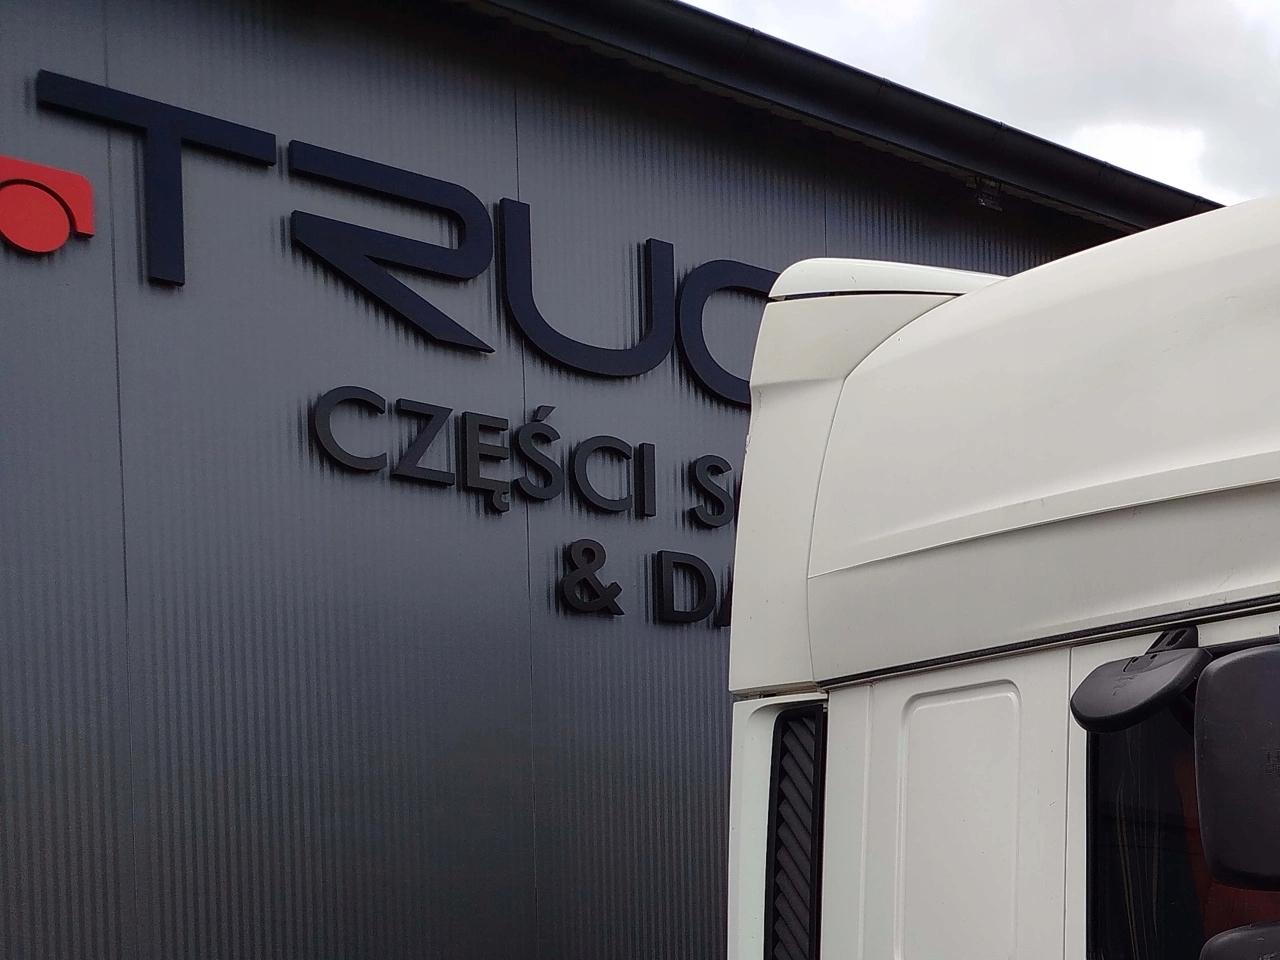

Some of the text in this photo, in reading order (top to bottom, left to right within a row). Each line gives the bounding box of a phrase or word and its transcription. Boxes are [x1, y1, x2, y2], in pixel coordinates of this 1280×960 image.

[313, 386, 656, 517] CZĘŚCI
[561, 539, 732, 628] & D
